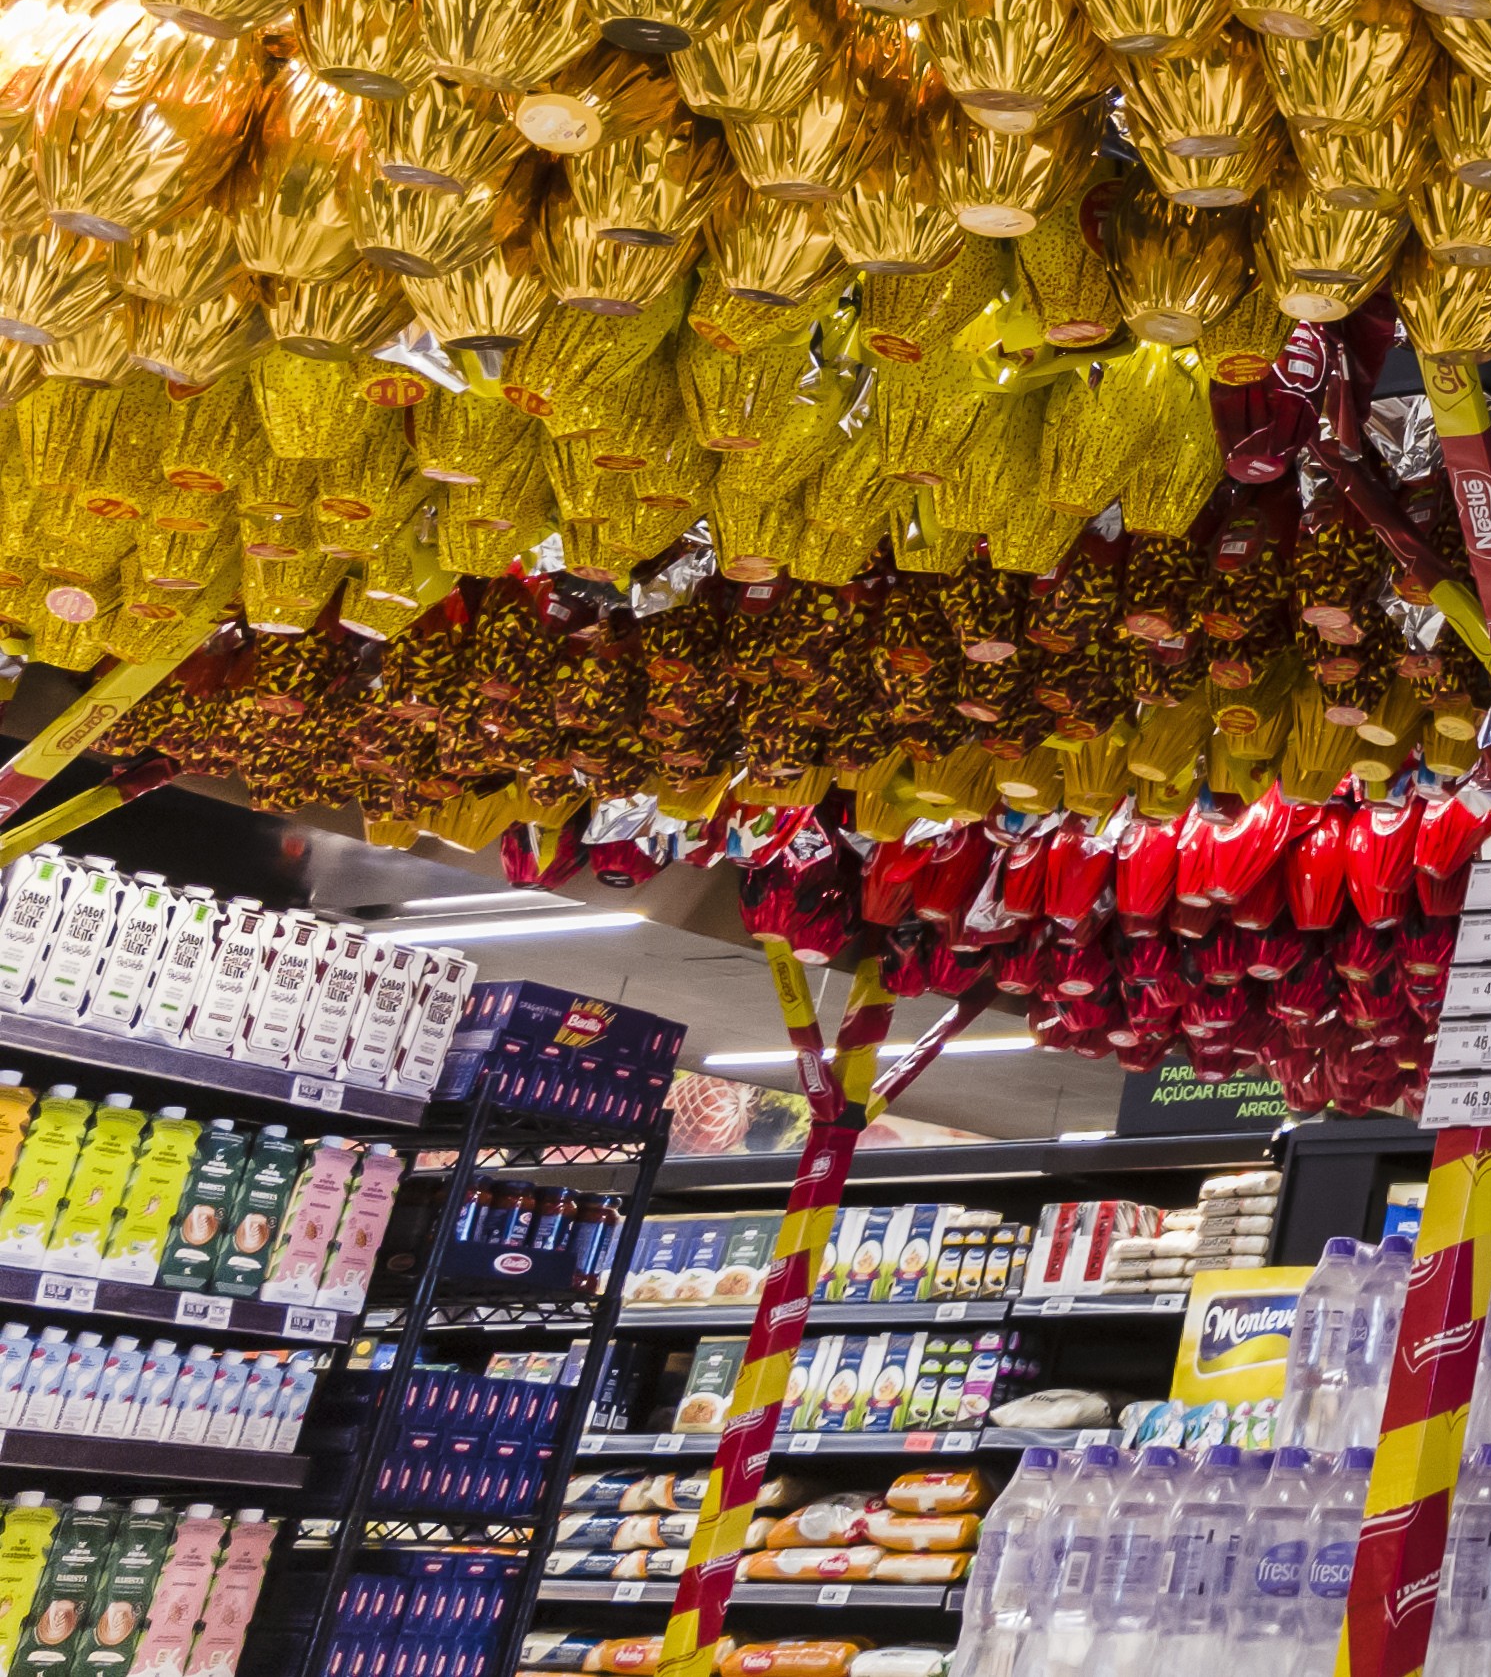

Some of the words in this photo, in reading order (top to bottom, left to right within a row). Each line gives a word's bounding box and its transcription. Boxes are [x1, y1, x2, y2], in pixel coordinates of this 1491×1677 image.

[59, 704, 119, 751] Garoto
[1151, 1083, 1214, 1106] AÇÚCAR
[1217, 1080, 1285, 1099] REFINAD
[1235, 1100, 1289, 1120] ARROZ
